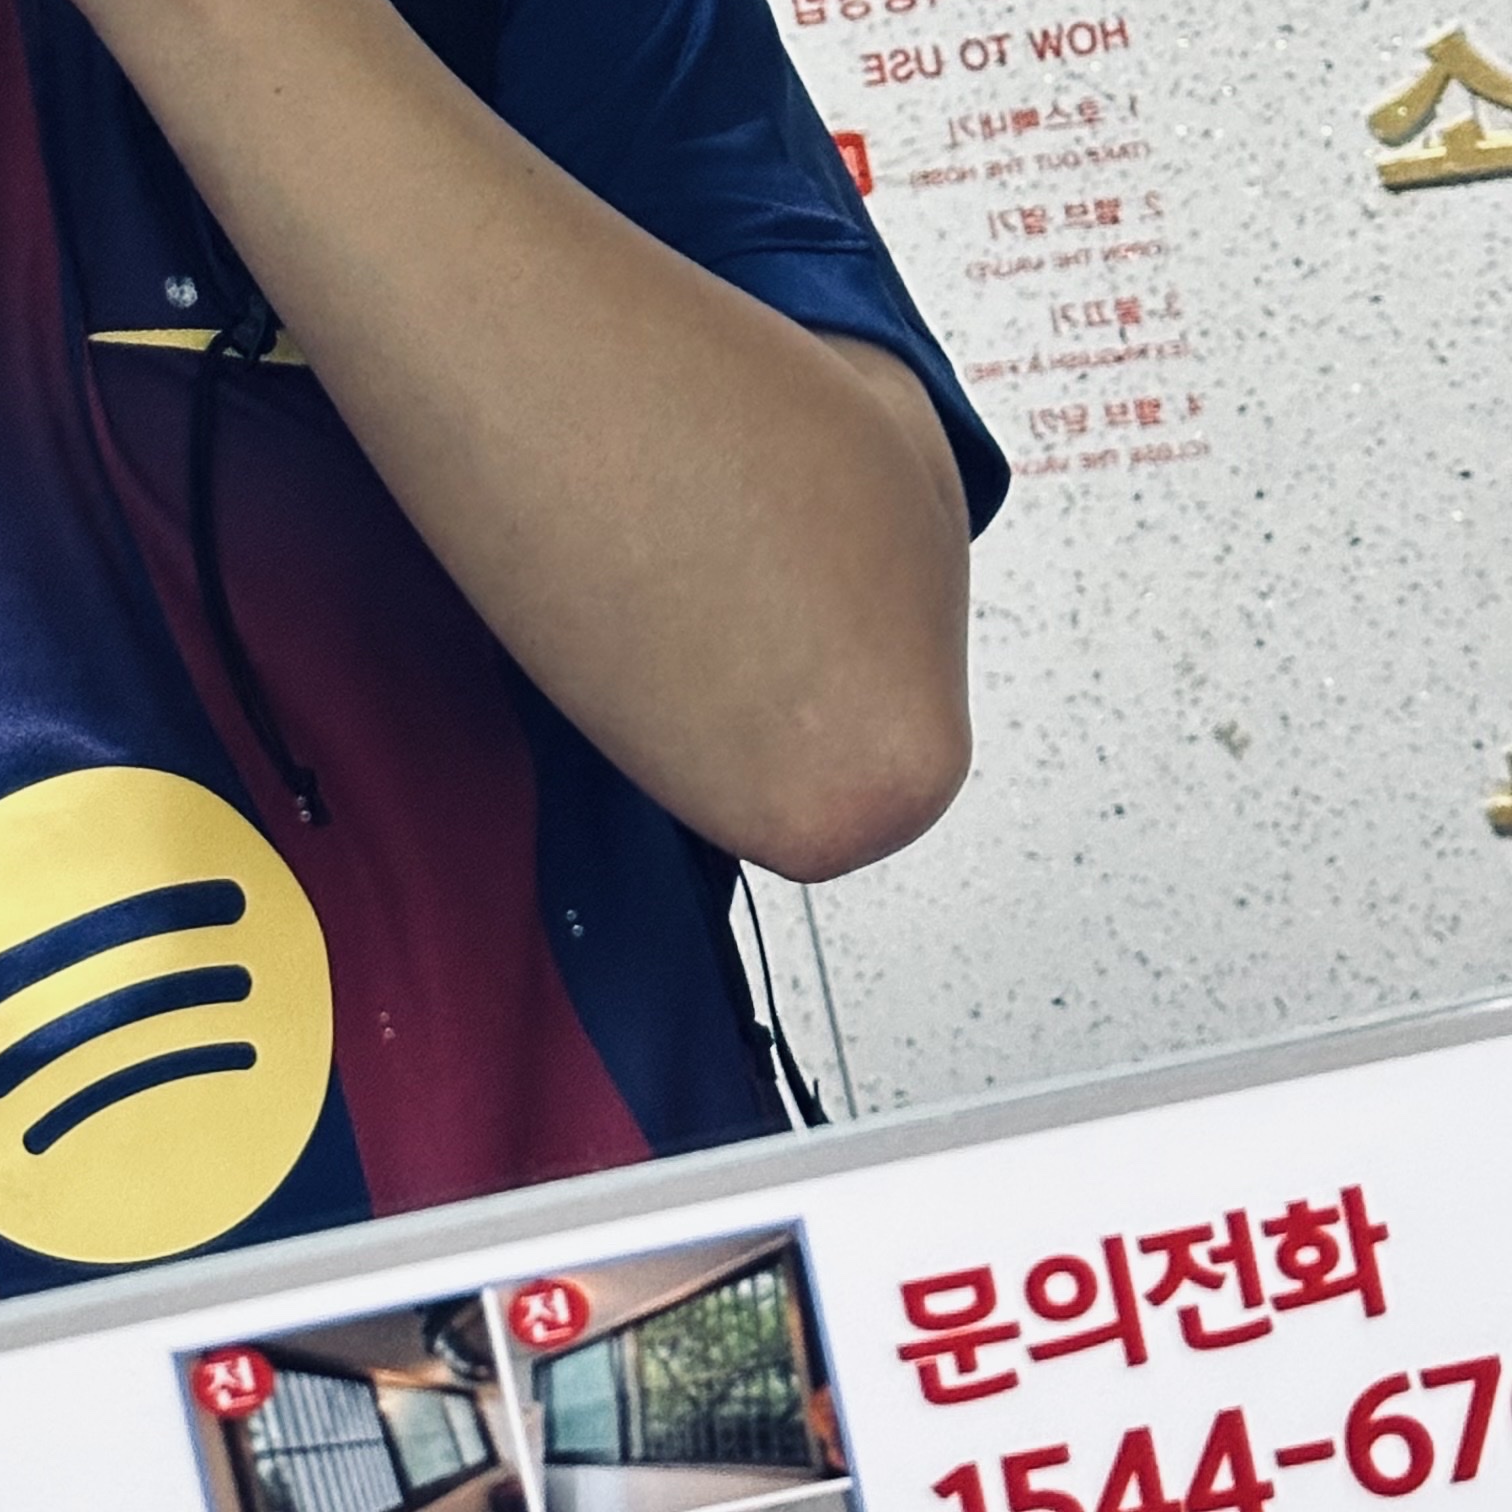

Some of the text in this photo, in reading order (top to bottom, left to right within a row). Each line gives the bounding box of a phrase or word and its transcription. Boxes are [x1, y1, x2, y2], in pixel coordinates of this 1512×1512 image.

[518, 1286, 575, 1344] 전
[897, 1184, 1390, 1405] 문의전화
[203, 1355, 261, 1411] 전
